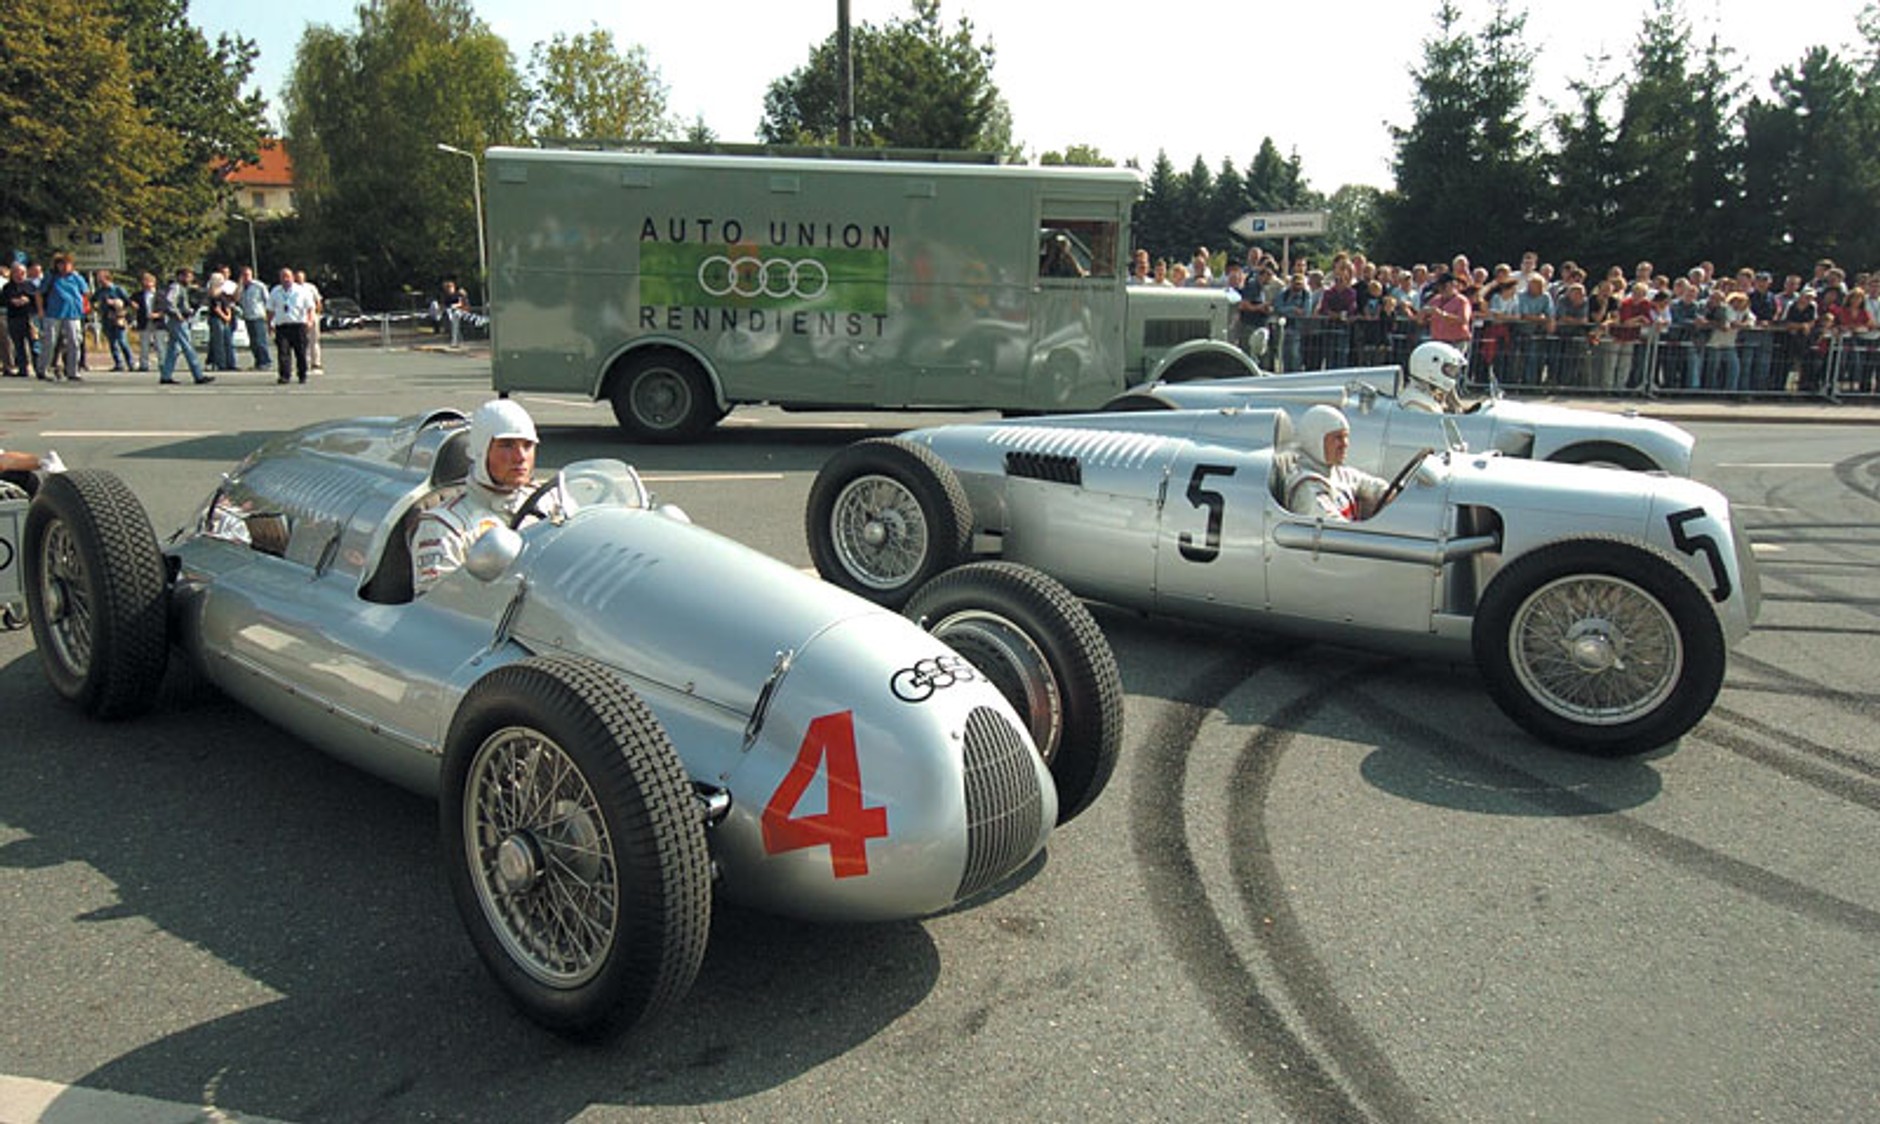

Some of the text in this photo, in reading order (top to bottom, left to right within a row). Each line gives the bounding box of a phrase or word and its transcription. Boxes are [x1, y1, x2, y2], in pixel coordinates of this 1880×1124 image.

[640, 217, 890, 248] AUTO UNION
[639, 306, 887, 336] RENNDIENST
[1178, 463, 1237, 563] 5
[1666, 506, 1732, 603] 5
[761, 710, 888, 879] 4
